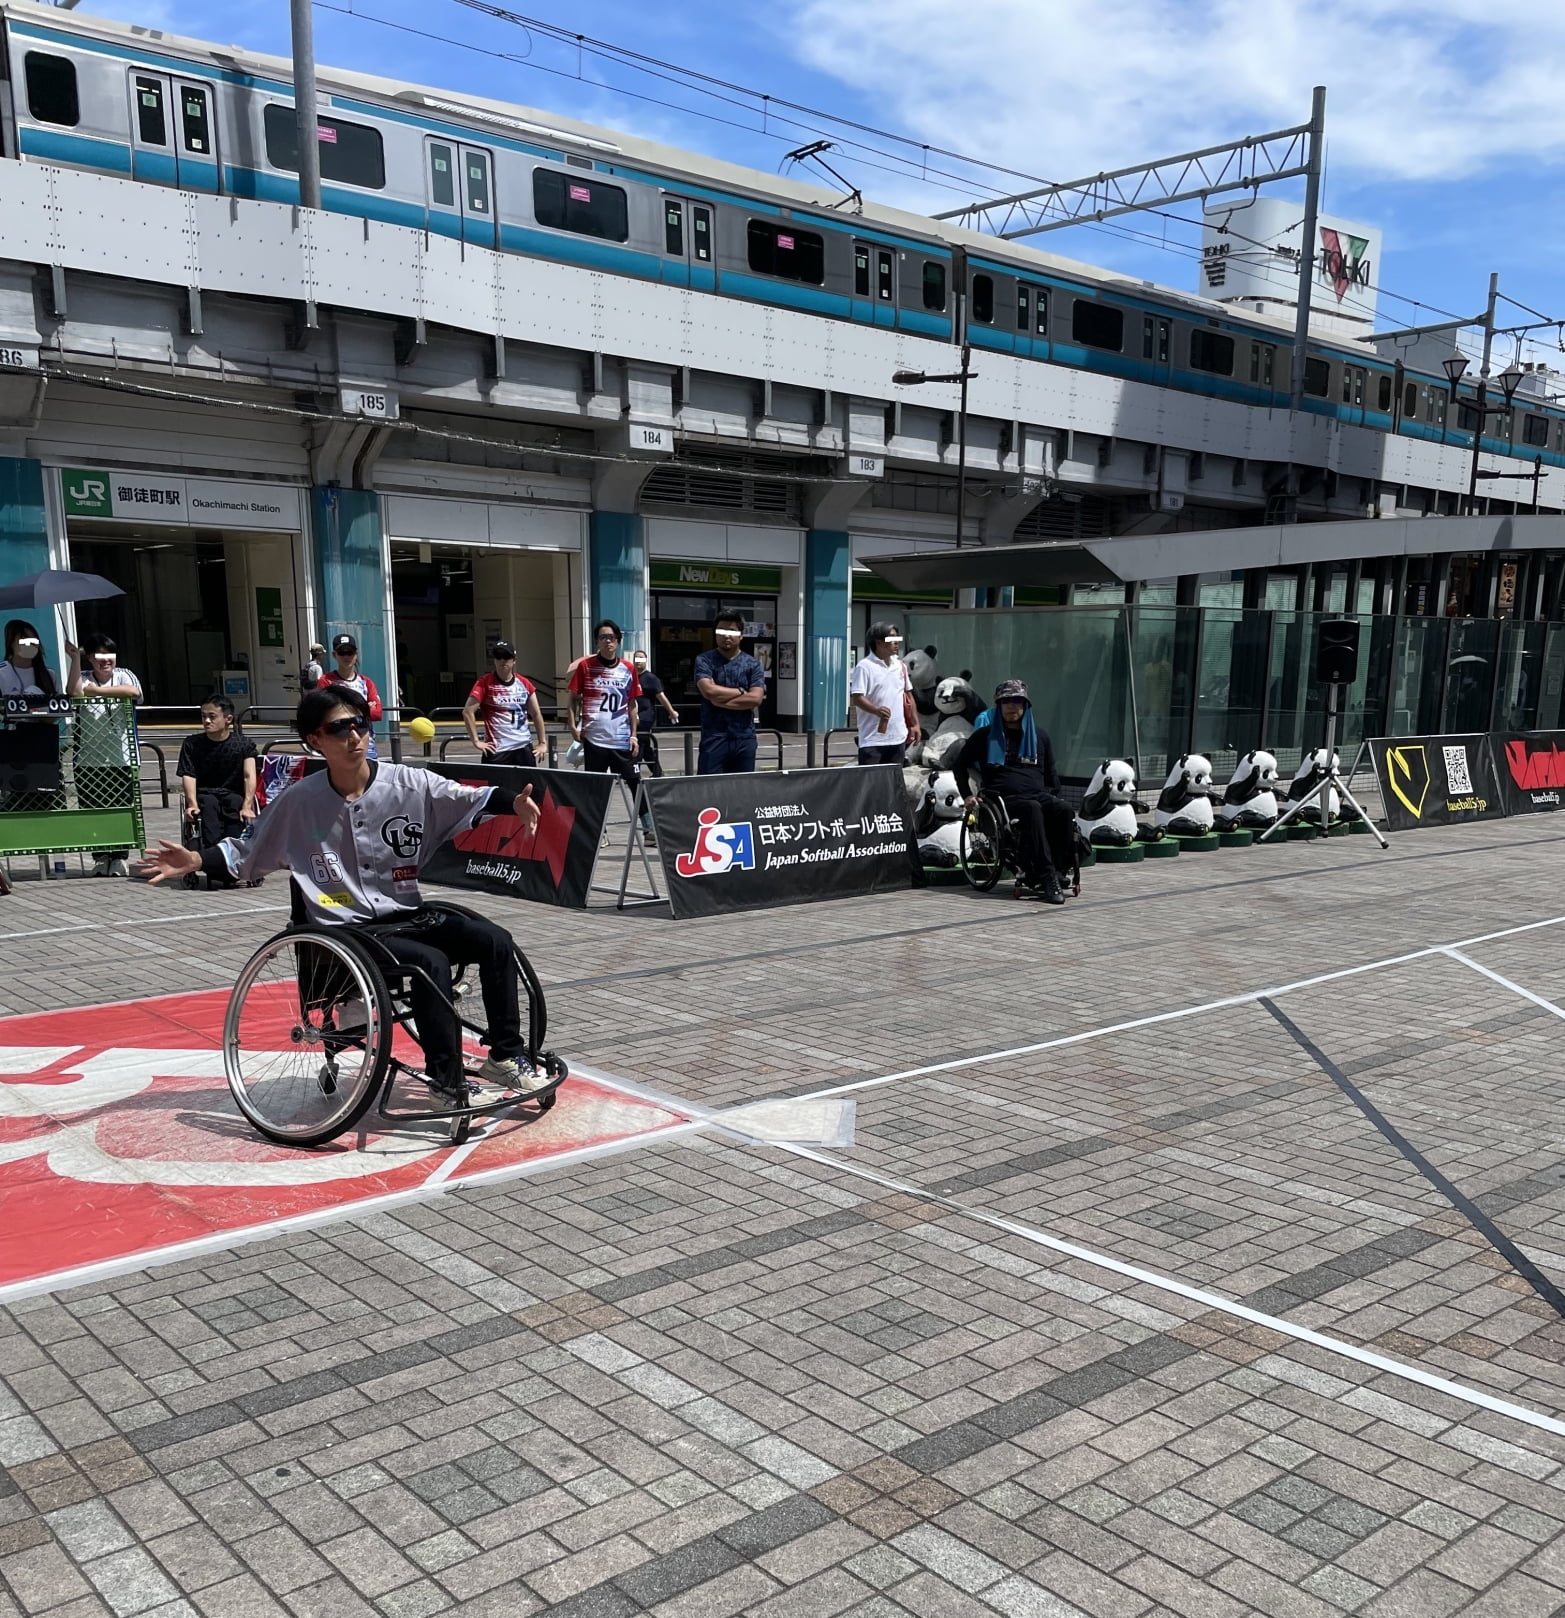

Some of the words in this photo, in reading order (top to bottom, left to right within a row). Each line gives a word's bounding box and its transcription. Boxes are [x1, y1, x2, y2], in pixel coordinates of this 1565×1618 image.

[360, 394, 385, 411] 185
[643, 430, 662, 445] 184
[860, 458, 875, 471] 183
[69, 480, 106, 501] JR
[118, 486, 181, 506] 御徒町駅
[192, 498, 249, 512] Okachimachi
[250, 502, 281, 514] Station
[8, 699, 28, 712] 03
[49, 698, 70, 711] 00
[600, 692, 618, 713] 20
[754, 804, 809, 819] 公益財団法人
[758, 812, 904, 846] 日本ソフトボール協会
[764, 851, 799, 871] Japan
[800, 846, 845, 864] Softball
[846, 840, 907, 859] Association
[310, 852, 344, 885] 66
[466, 858, 522, 884] baseball5.jp
